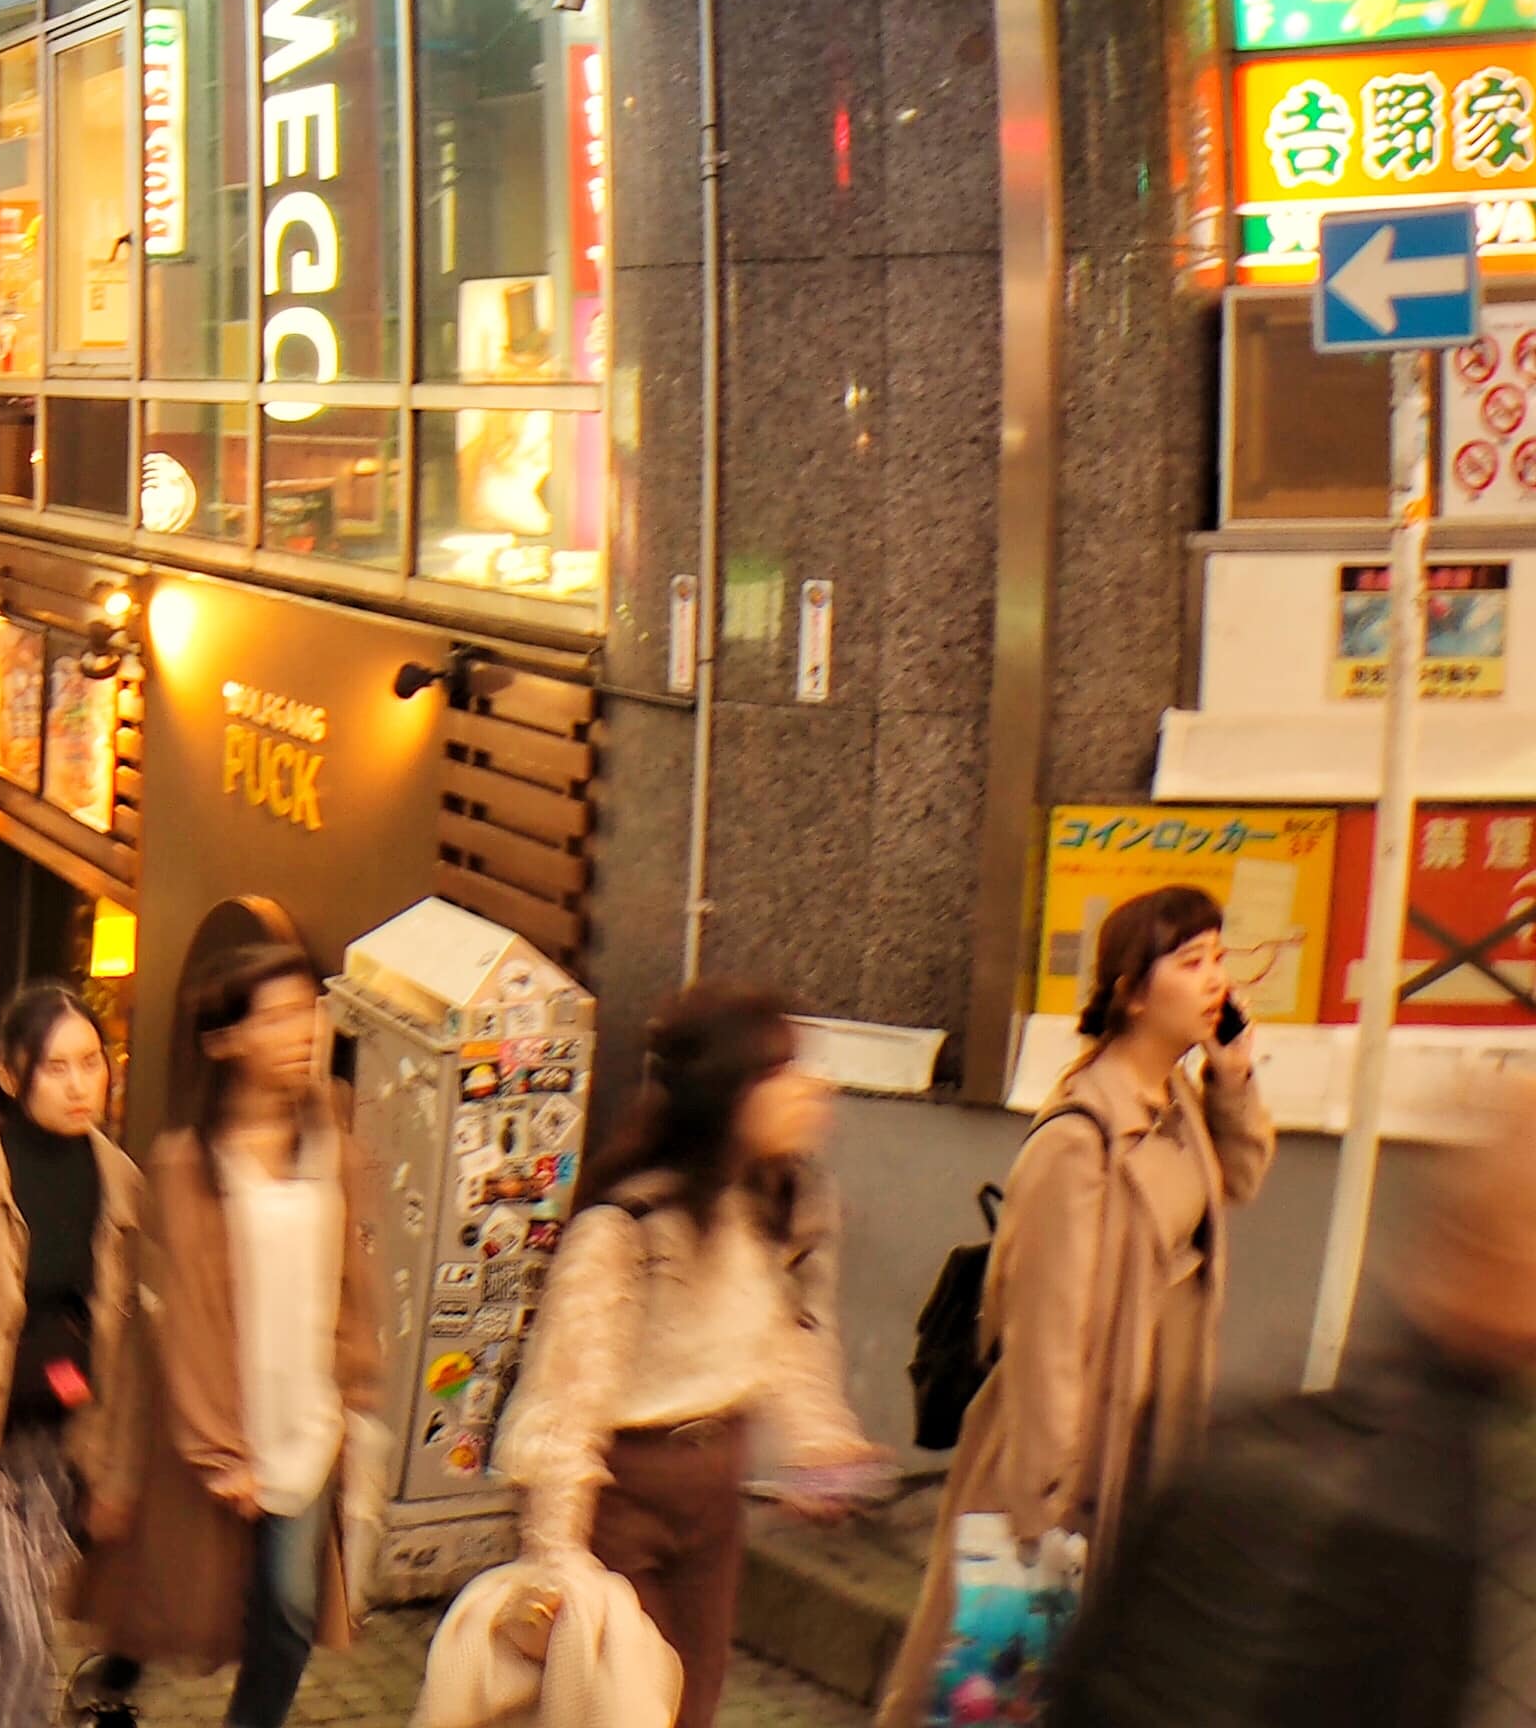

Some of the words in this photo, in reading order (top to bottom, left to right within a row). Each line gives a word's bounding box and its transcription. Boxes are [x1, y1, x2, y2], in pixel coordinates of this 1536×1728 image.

[1265, 66, 1534, 188] 吉野家
[223, 724, 324, 832] PUCK
[1058, 817, 1278, 855] コインロッカー
